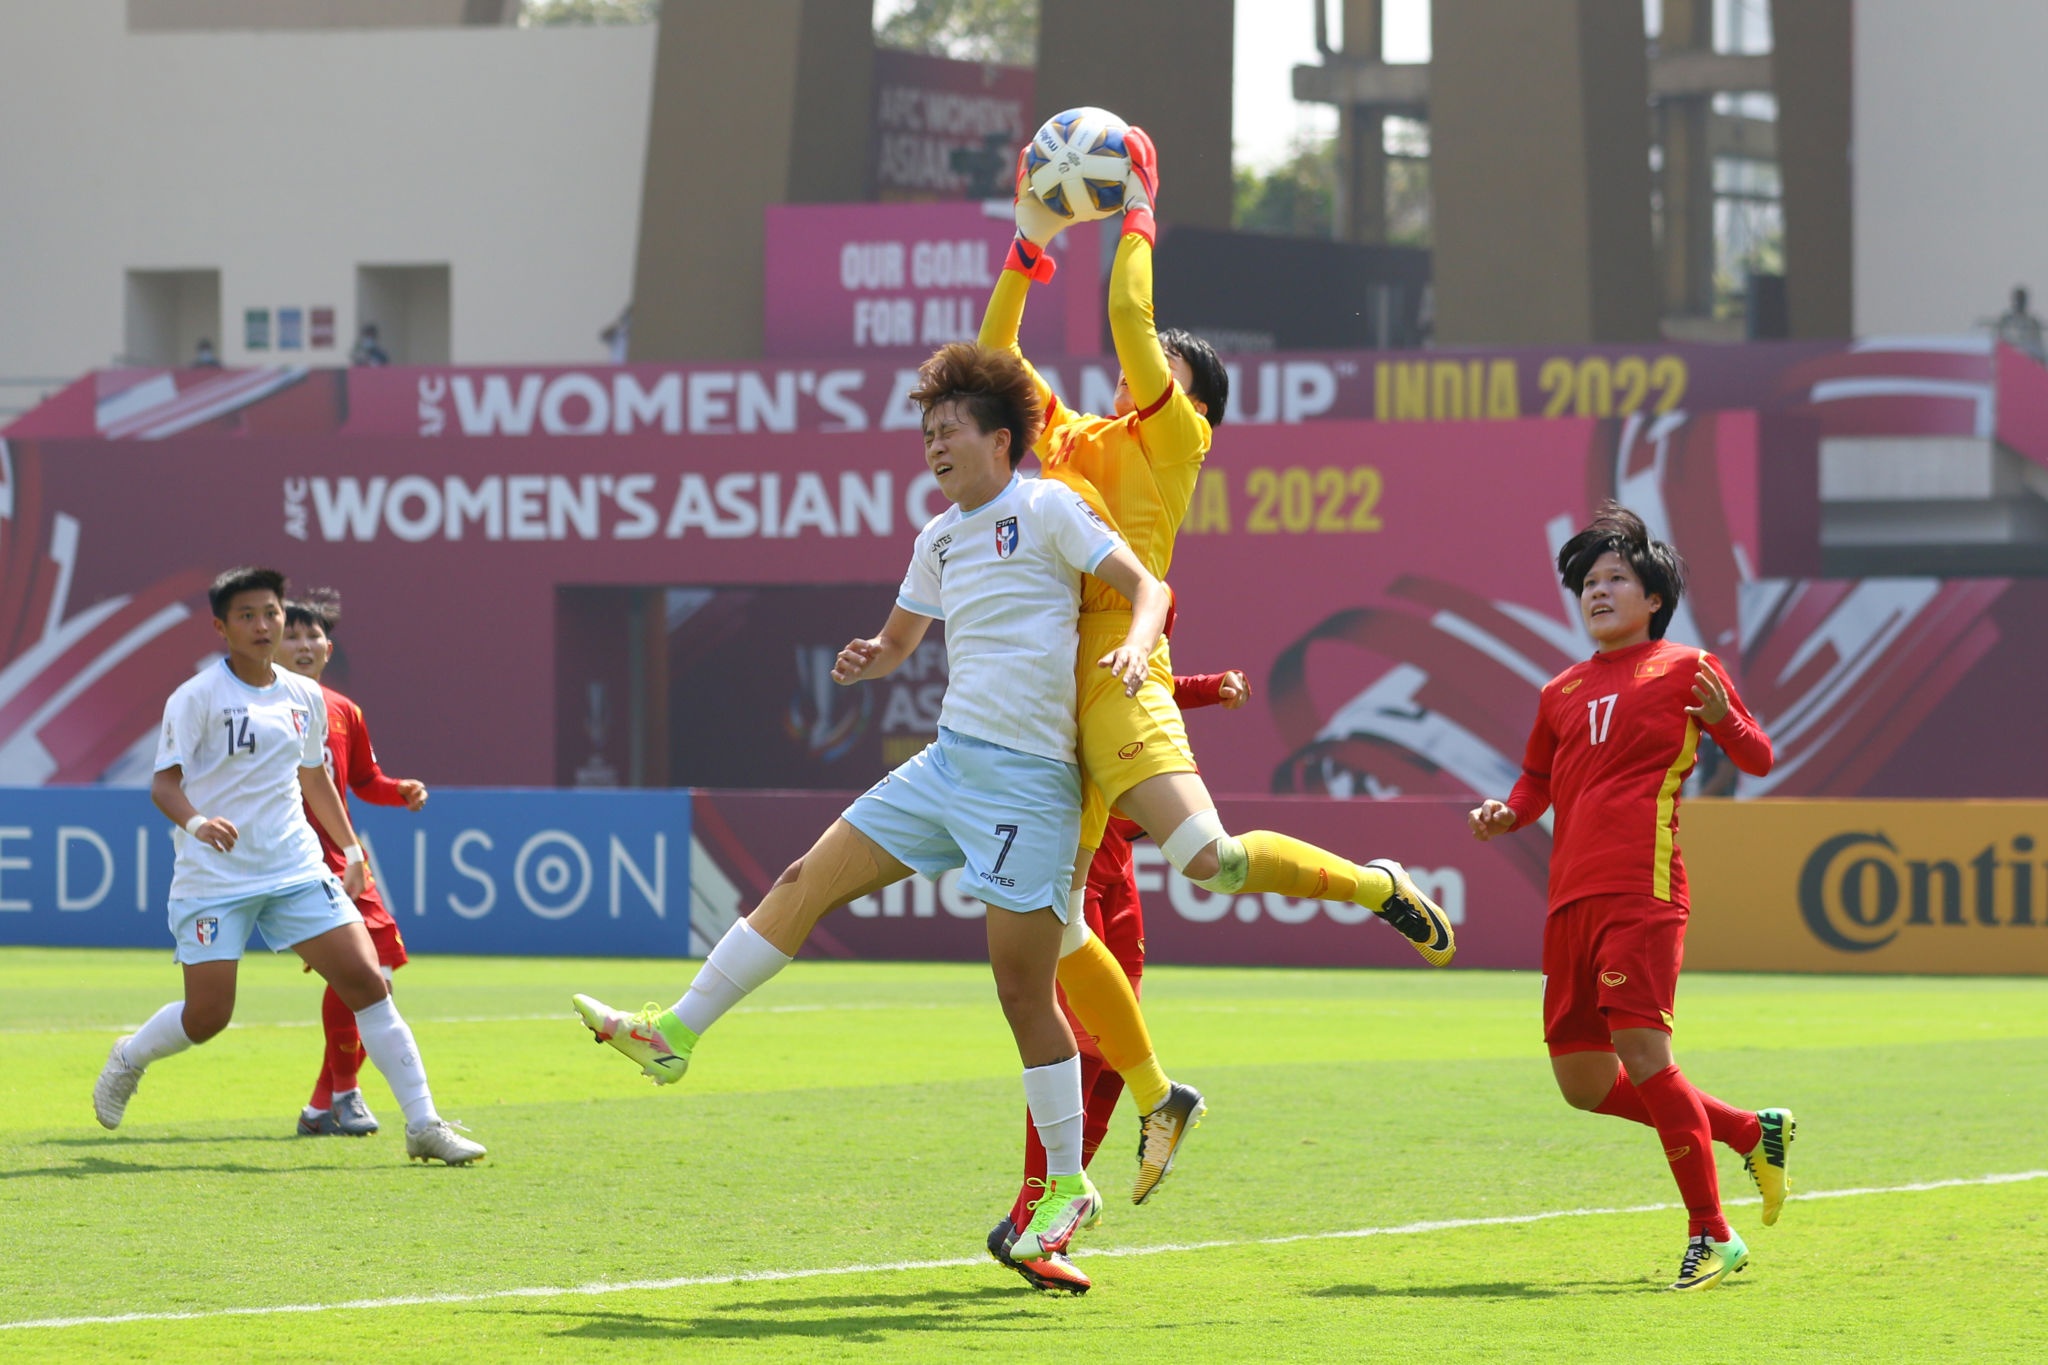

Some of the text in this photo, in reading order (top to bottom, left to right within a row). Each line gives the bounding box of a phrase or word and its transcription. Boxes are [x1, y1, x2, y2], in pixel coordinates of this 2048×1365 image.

[840, 239, 993, 289] OUR GOAL
[853, 298, 979, 346] FOR ALL
[451, 371, 867, 437] WOMEN'S
[1374, 358, 1521, 422] INDIA
[1538, 355, 1688, 419] 2022
[284, 476, 309, 542] AFC
[309, 473, 659, 542] WOMEN'S
[665, 471, 893, 538] ASIAN
[1245, 466, 1383, 535] 2022
[224, 716, 256, 757] 14
[1587, 693, 1619, 746] 17
[0, 826, 176, 912] EDI
[994, 823, 1019, 874] 7
[1796, 831, 2048, 952] Conti
[1758, 1113, 1785, 1169] NIKE
